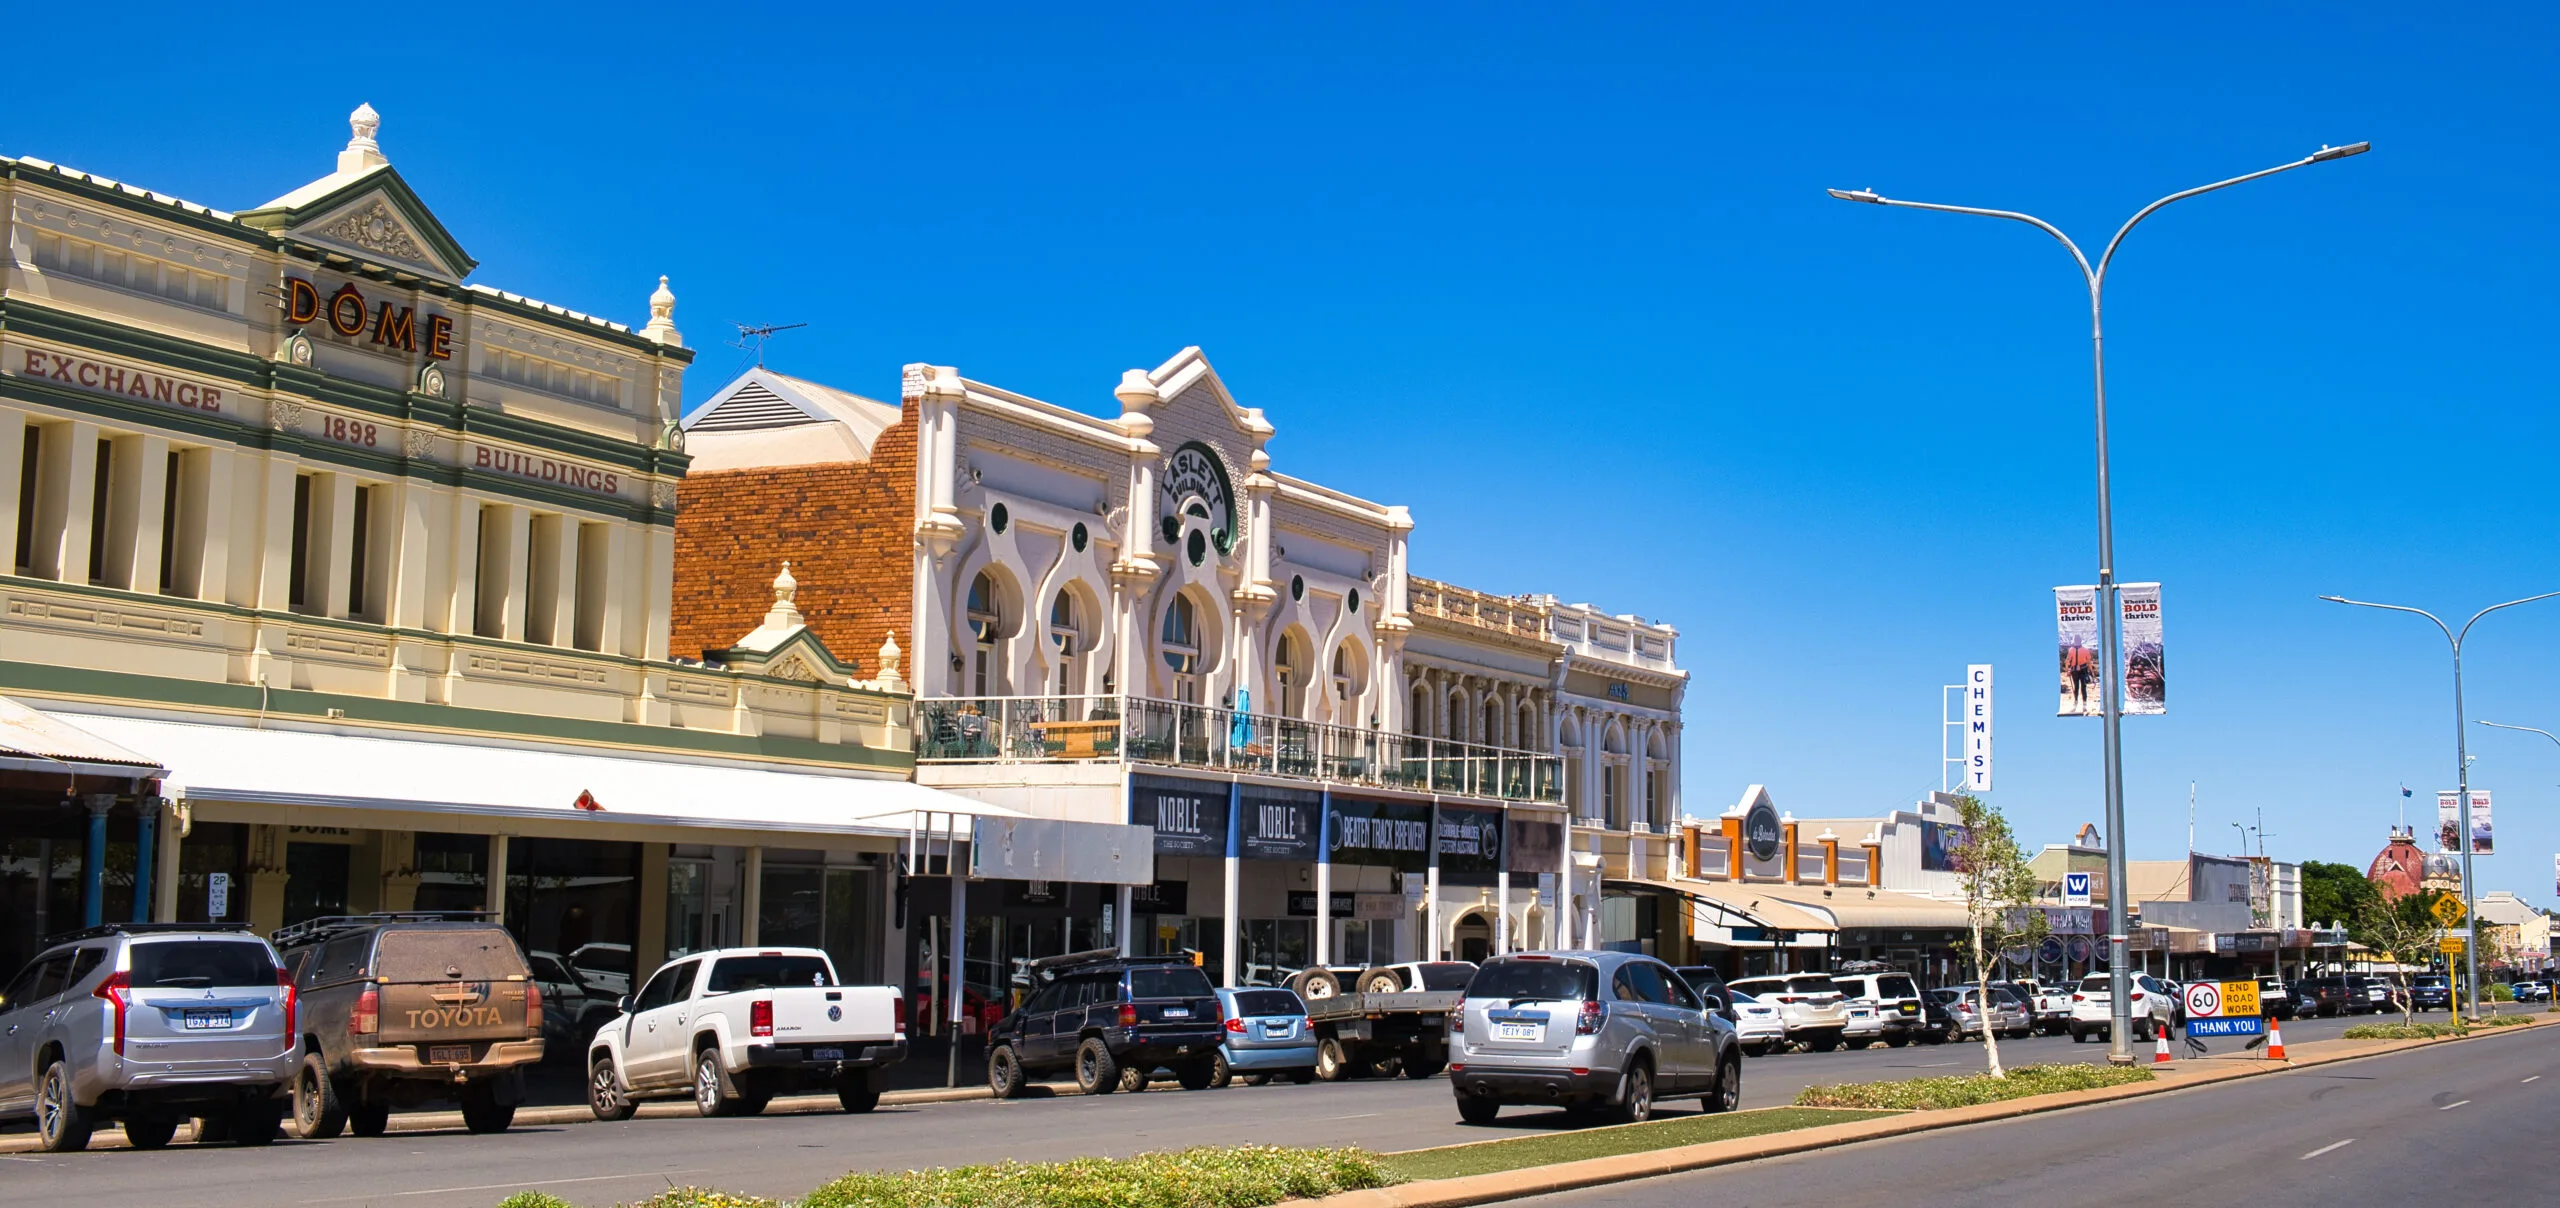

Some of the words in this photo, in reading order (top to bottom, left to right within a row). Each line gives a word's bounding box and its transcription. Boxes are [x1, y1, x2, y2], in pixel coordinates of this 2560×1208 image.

[23, 349, 222, 413] EXCHANGE
[323, 415, 378, 447] 1898
[475, 445, 618, 495] BUILDINGS
[1162, 453, 1224, 505] LASLETT
[2060, 606, 2093, 614] BOLD
[2124, 604, 2158, 613] BOLD
[2125, 612, 2159, 620] thrive.
[2061, 614, 2094, 622] thrive.
[1973, 670, 1985, 783] CHEMIST
[1157, 796, 1201, 834] NOBLE
[1259, 804, 1296, 839] NOBLE
[1344, 815, 1370, 848] BEATEN
[1371, 818, 1394, 849] TRACK
[1394, 819, 1427, 852] BREWERY
[213, 876, 226, 886] 2P
[2228, 983, 2249, 992] END
[2192, 992, 2214, 1008] 60
[2226, 993, 2254, 1003] ROAD
[2226, 1004, 2255, 1014] WORK
[405, 1007, 503, 1029] TOYOTA
[2193, 1021, 2231, 1034] THANK
[2233, 1020, 2255, 1032] YOU
